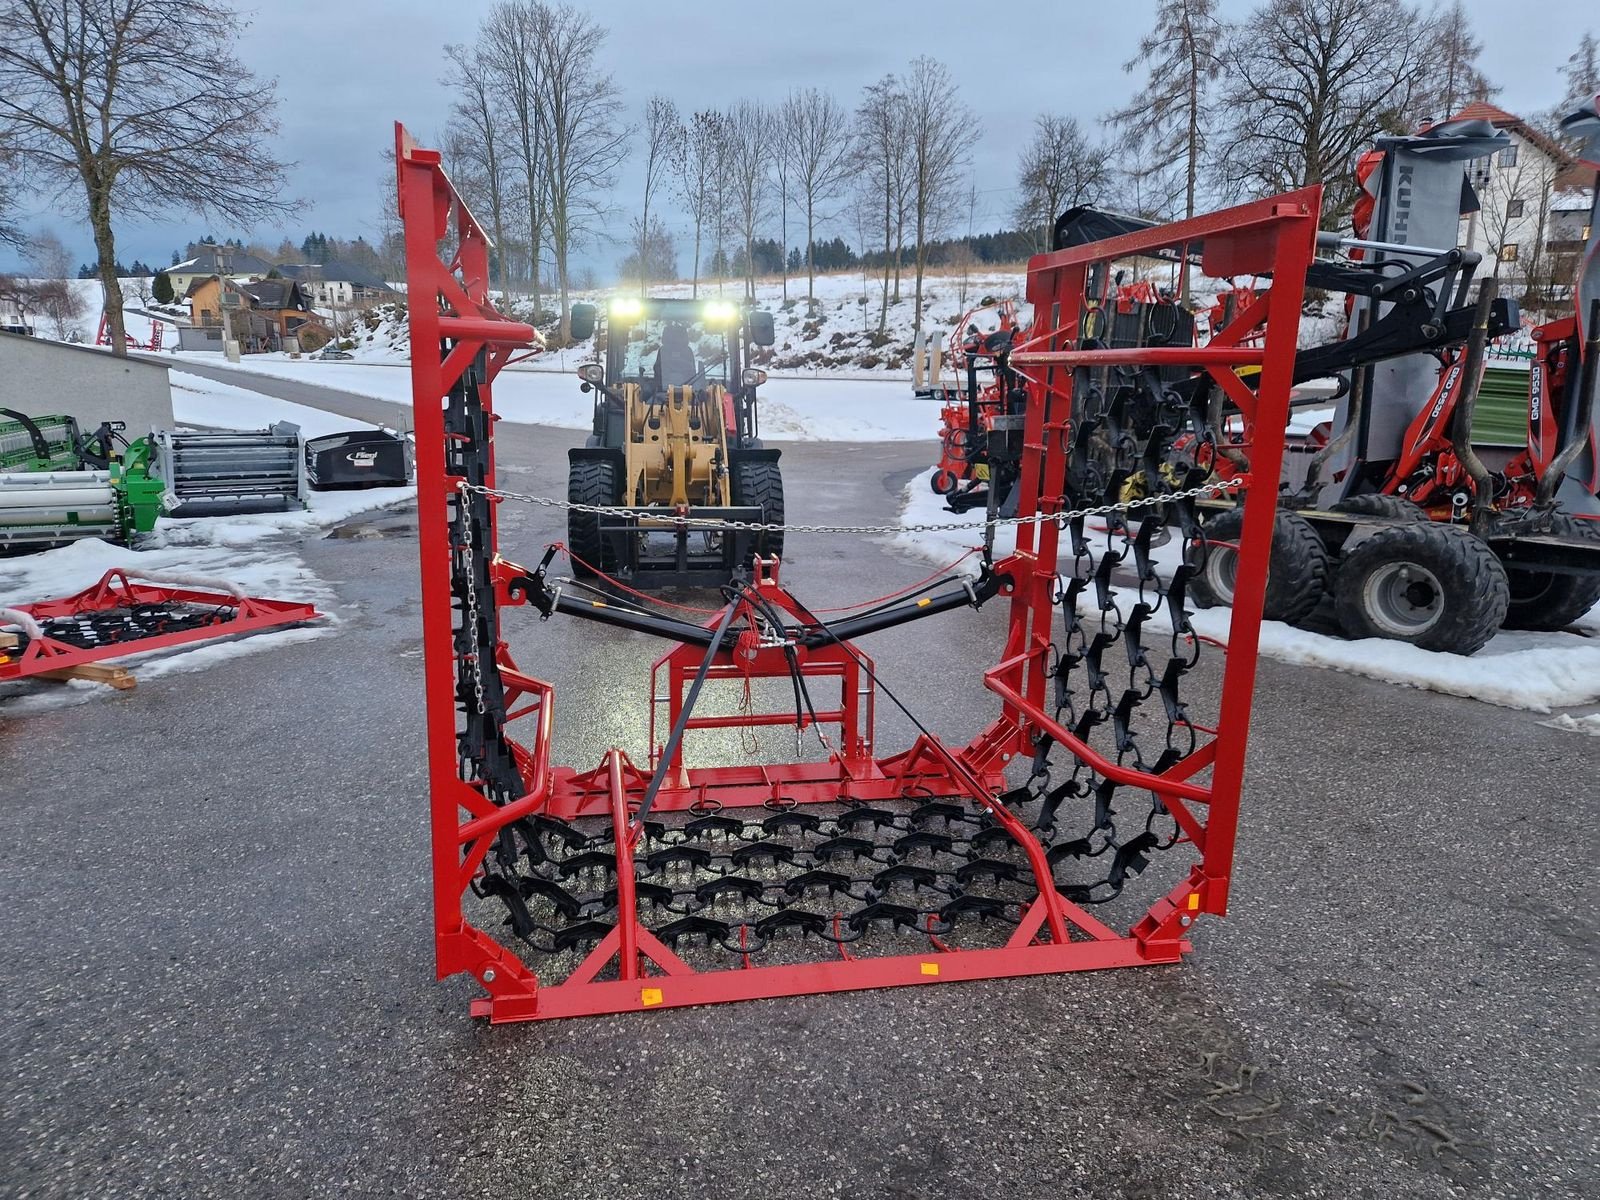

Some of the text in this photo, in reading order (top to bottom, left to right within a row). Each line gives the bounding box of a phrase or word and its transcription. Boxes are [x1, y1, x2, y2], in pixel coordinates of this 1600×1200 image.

[1446, 367, 1460, 389] GMD
[1531, 366, 1540, 420] GMD 9530
